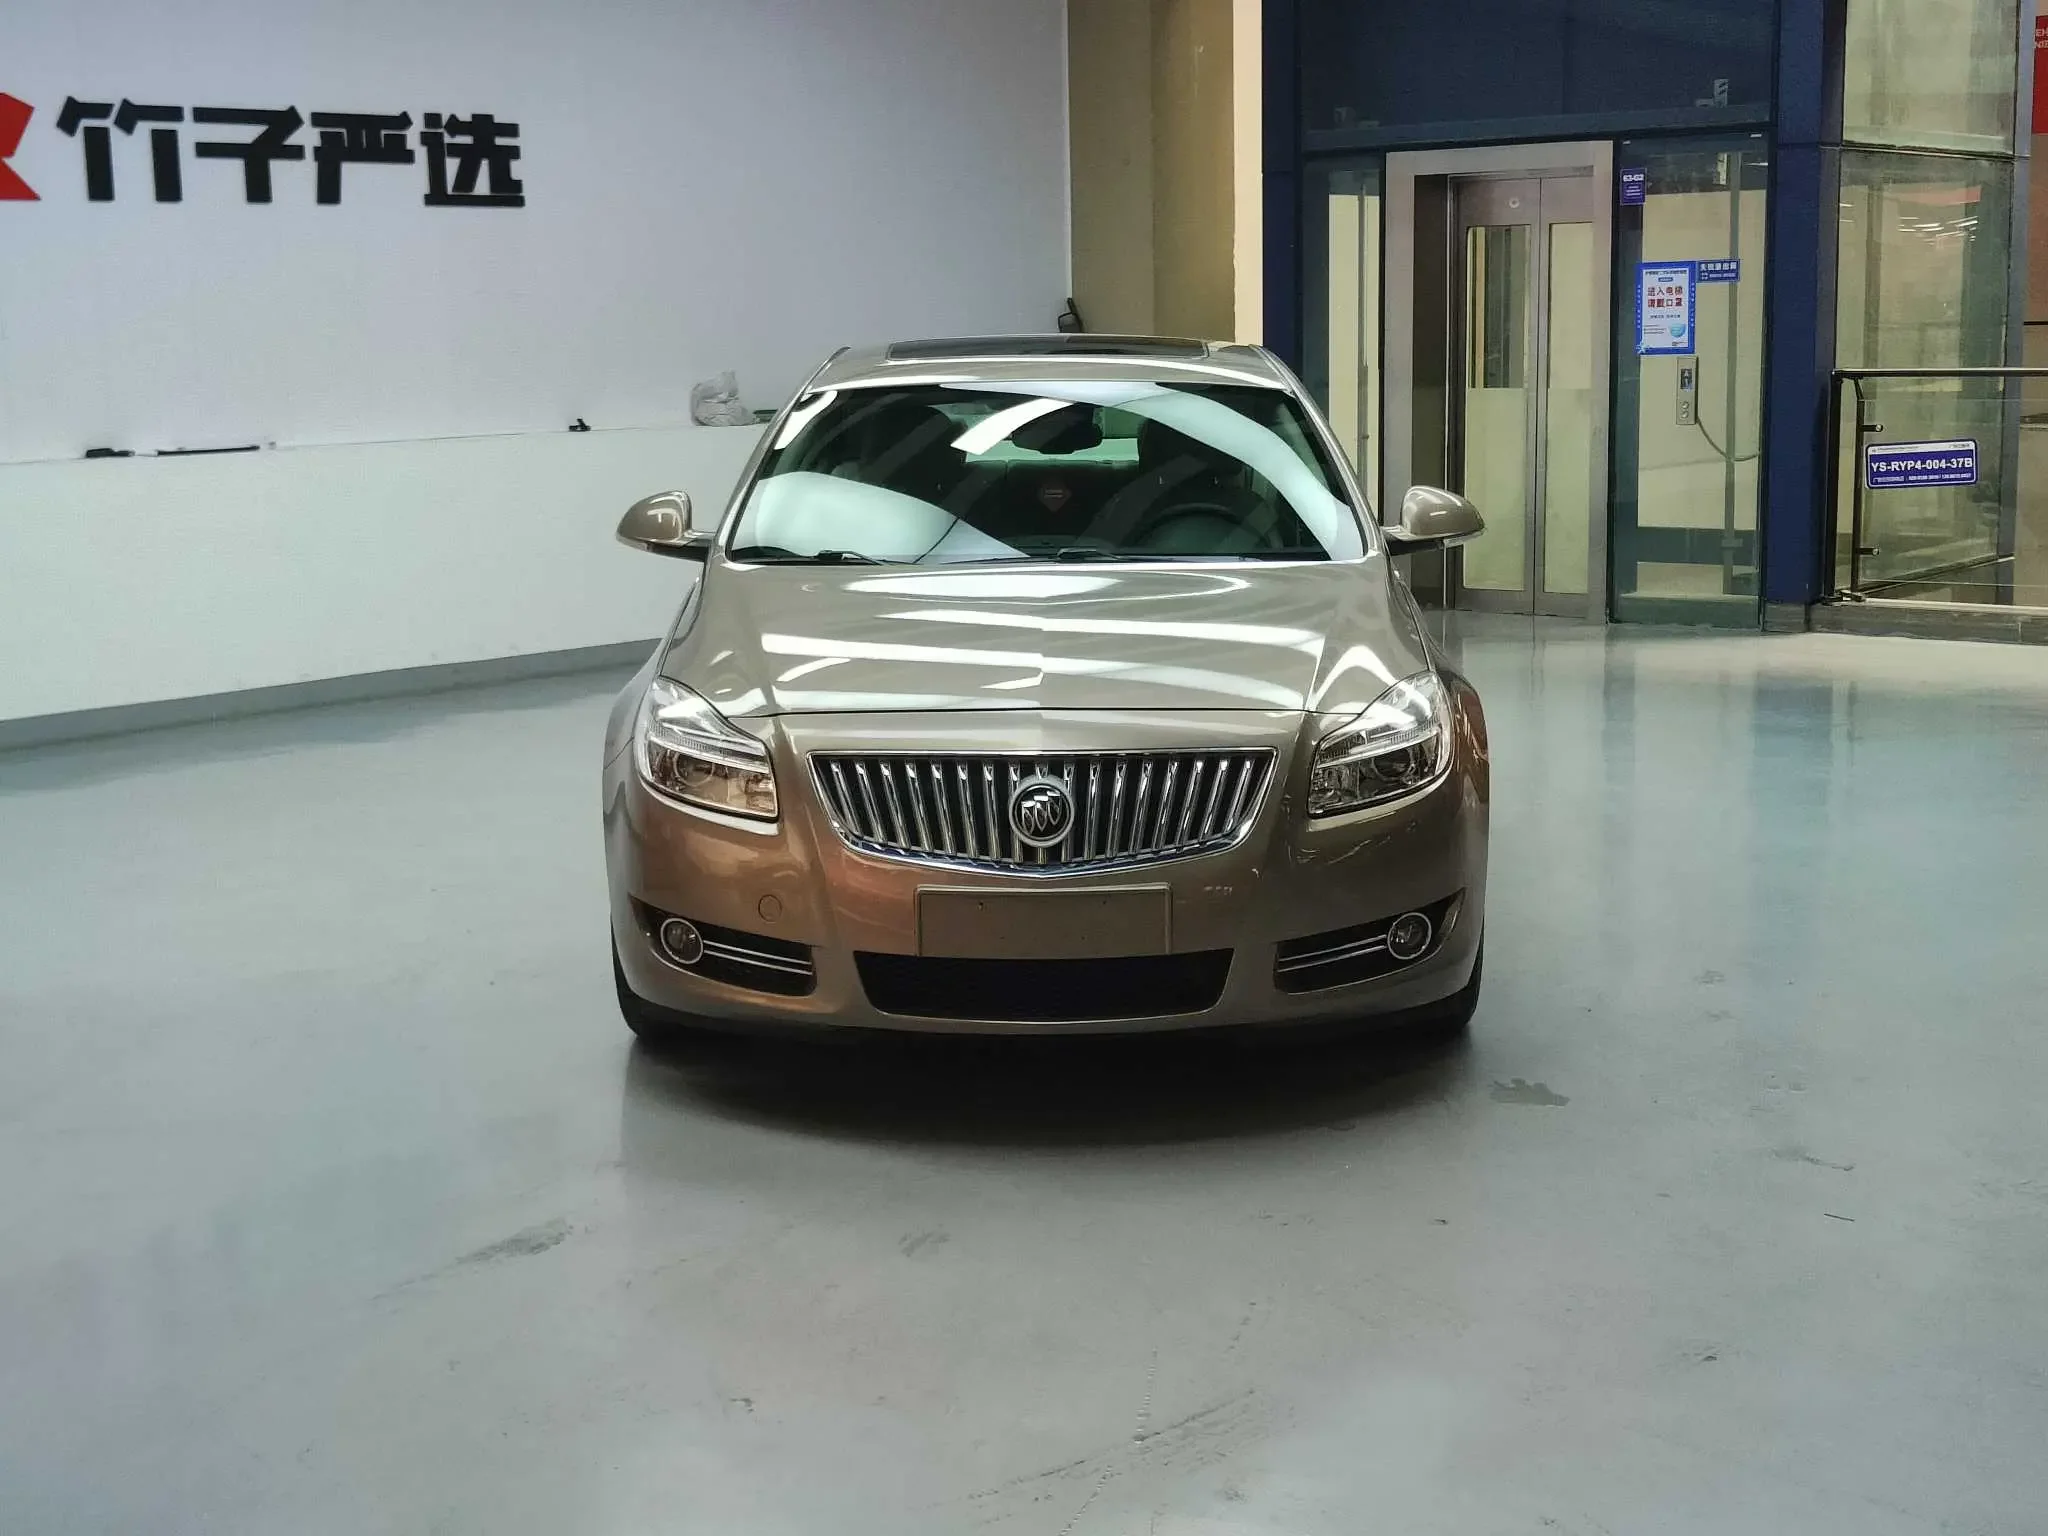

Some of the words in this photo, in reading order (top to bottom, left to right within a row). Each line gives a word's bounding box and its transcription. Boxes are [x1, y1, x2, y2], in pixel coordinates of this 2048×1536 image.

[56, 95, 526, 207] 竹子严选
[1647, 286, 1683, 297] 进入电梯
[1871, 458, 1973, 472] YS-RYP4-004-37B
